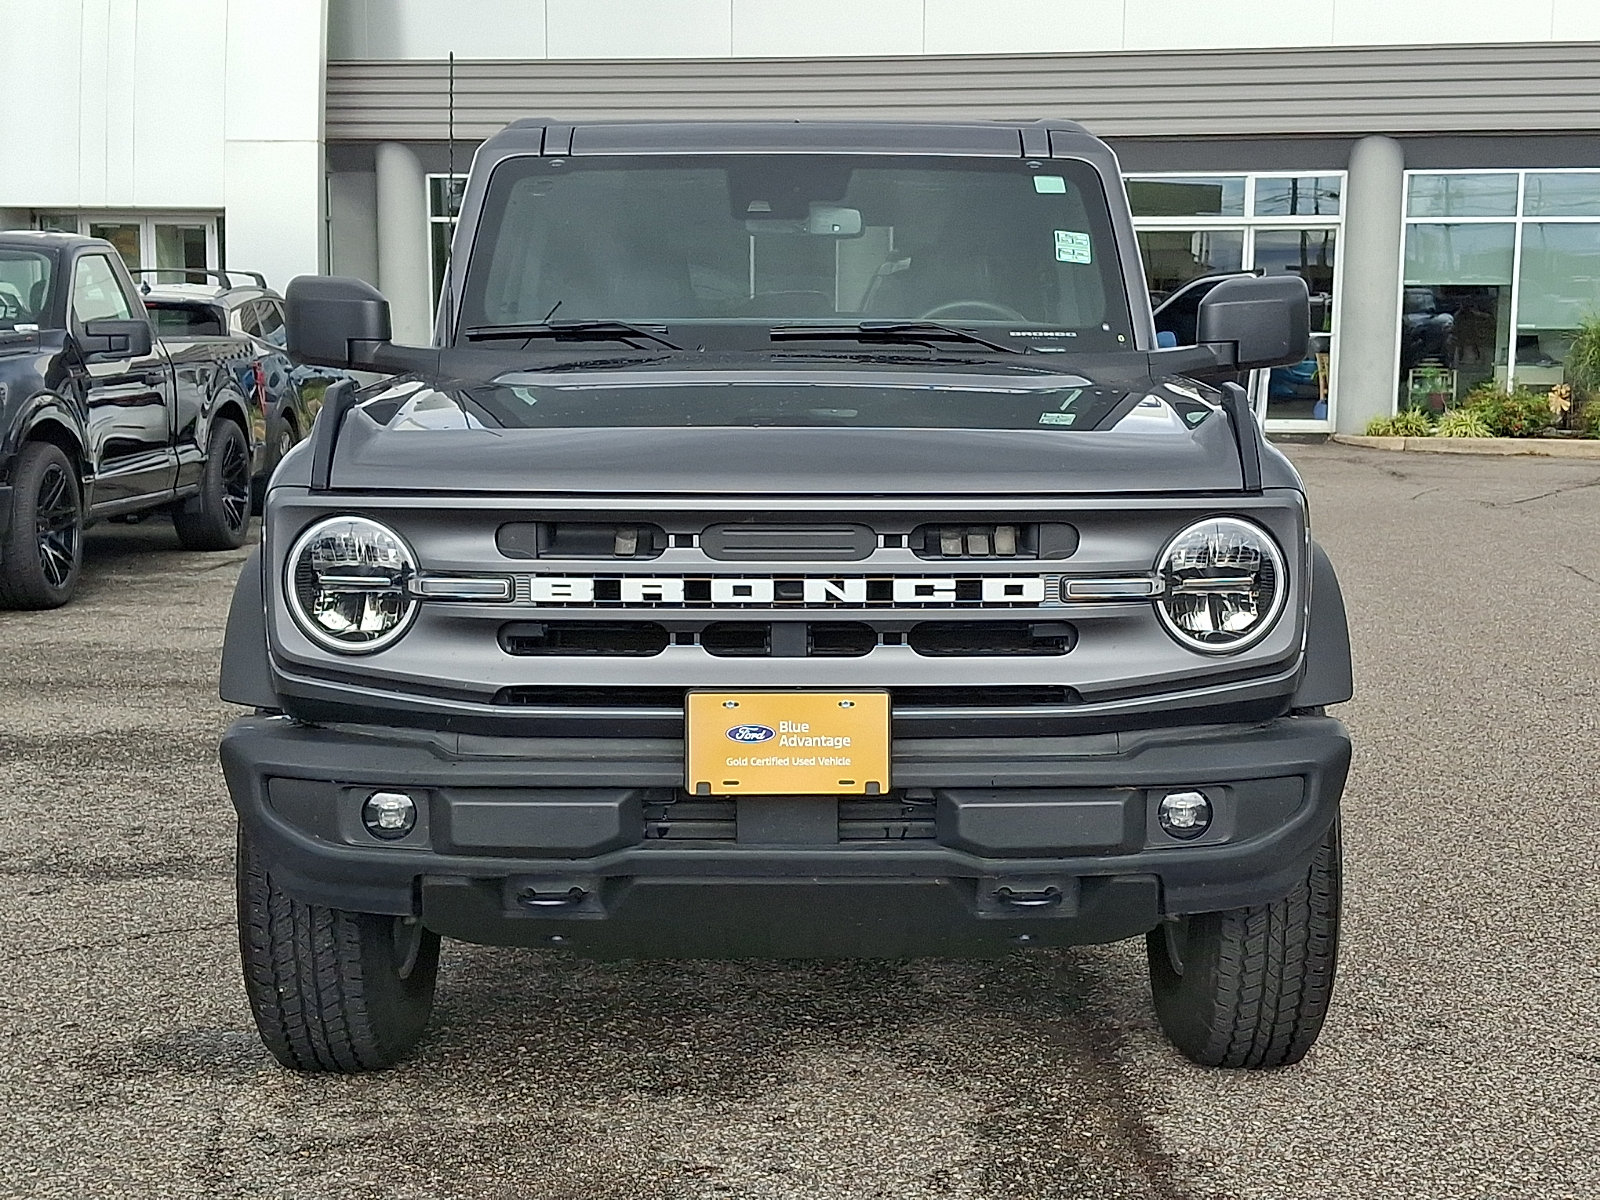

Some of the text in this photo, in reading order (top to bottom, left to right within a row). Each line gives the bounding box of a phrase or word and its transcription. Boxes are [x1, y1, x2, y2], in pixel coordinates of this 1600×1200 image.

[530, 577, 1046, 604] BRONCO
[734, 725, 768, 741] Ford
[779, 720, 809, 733] Blue
[779, 735, 851, 749] Advantage
[726, 756, 851, 767] Gold Certified Used Vehicle
